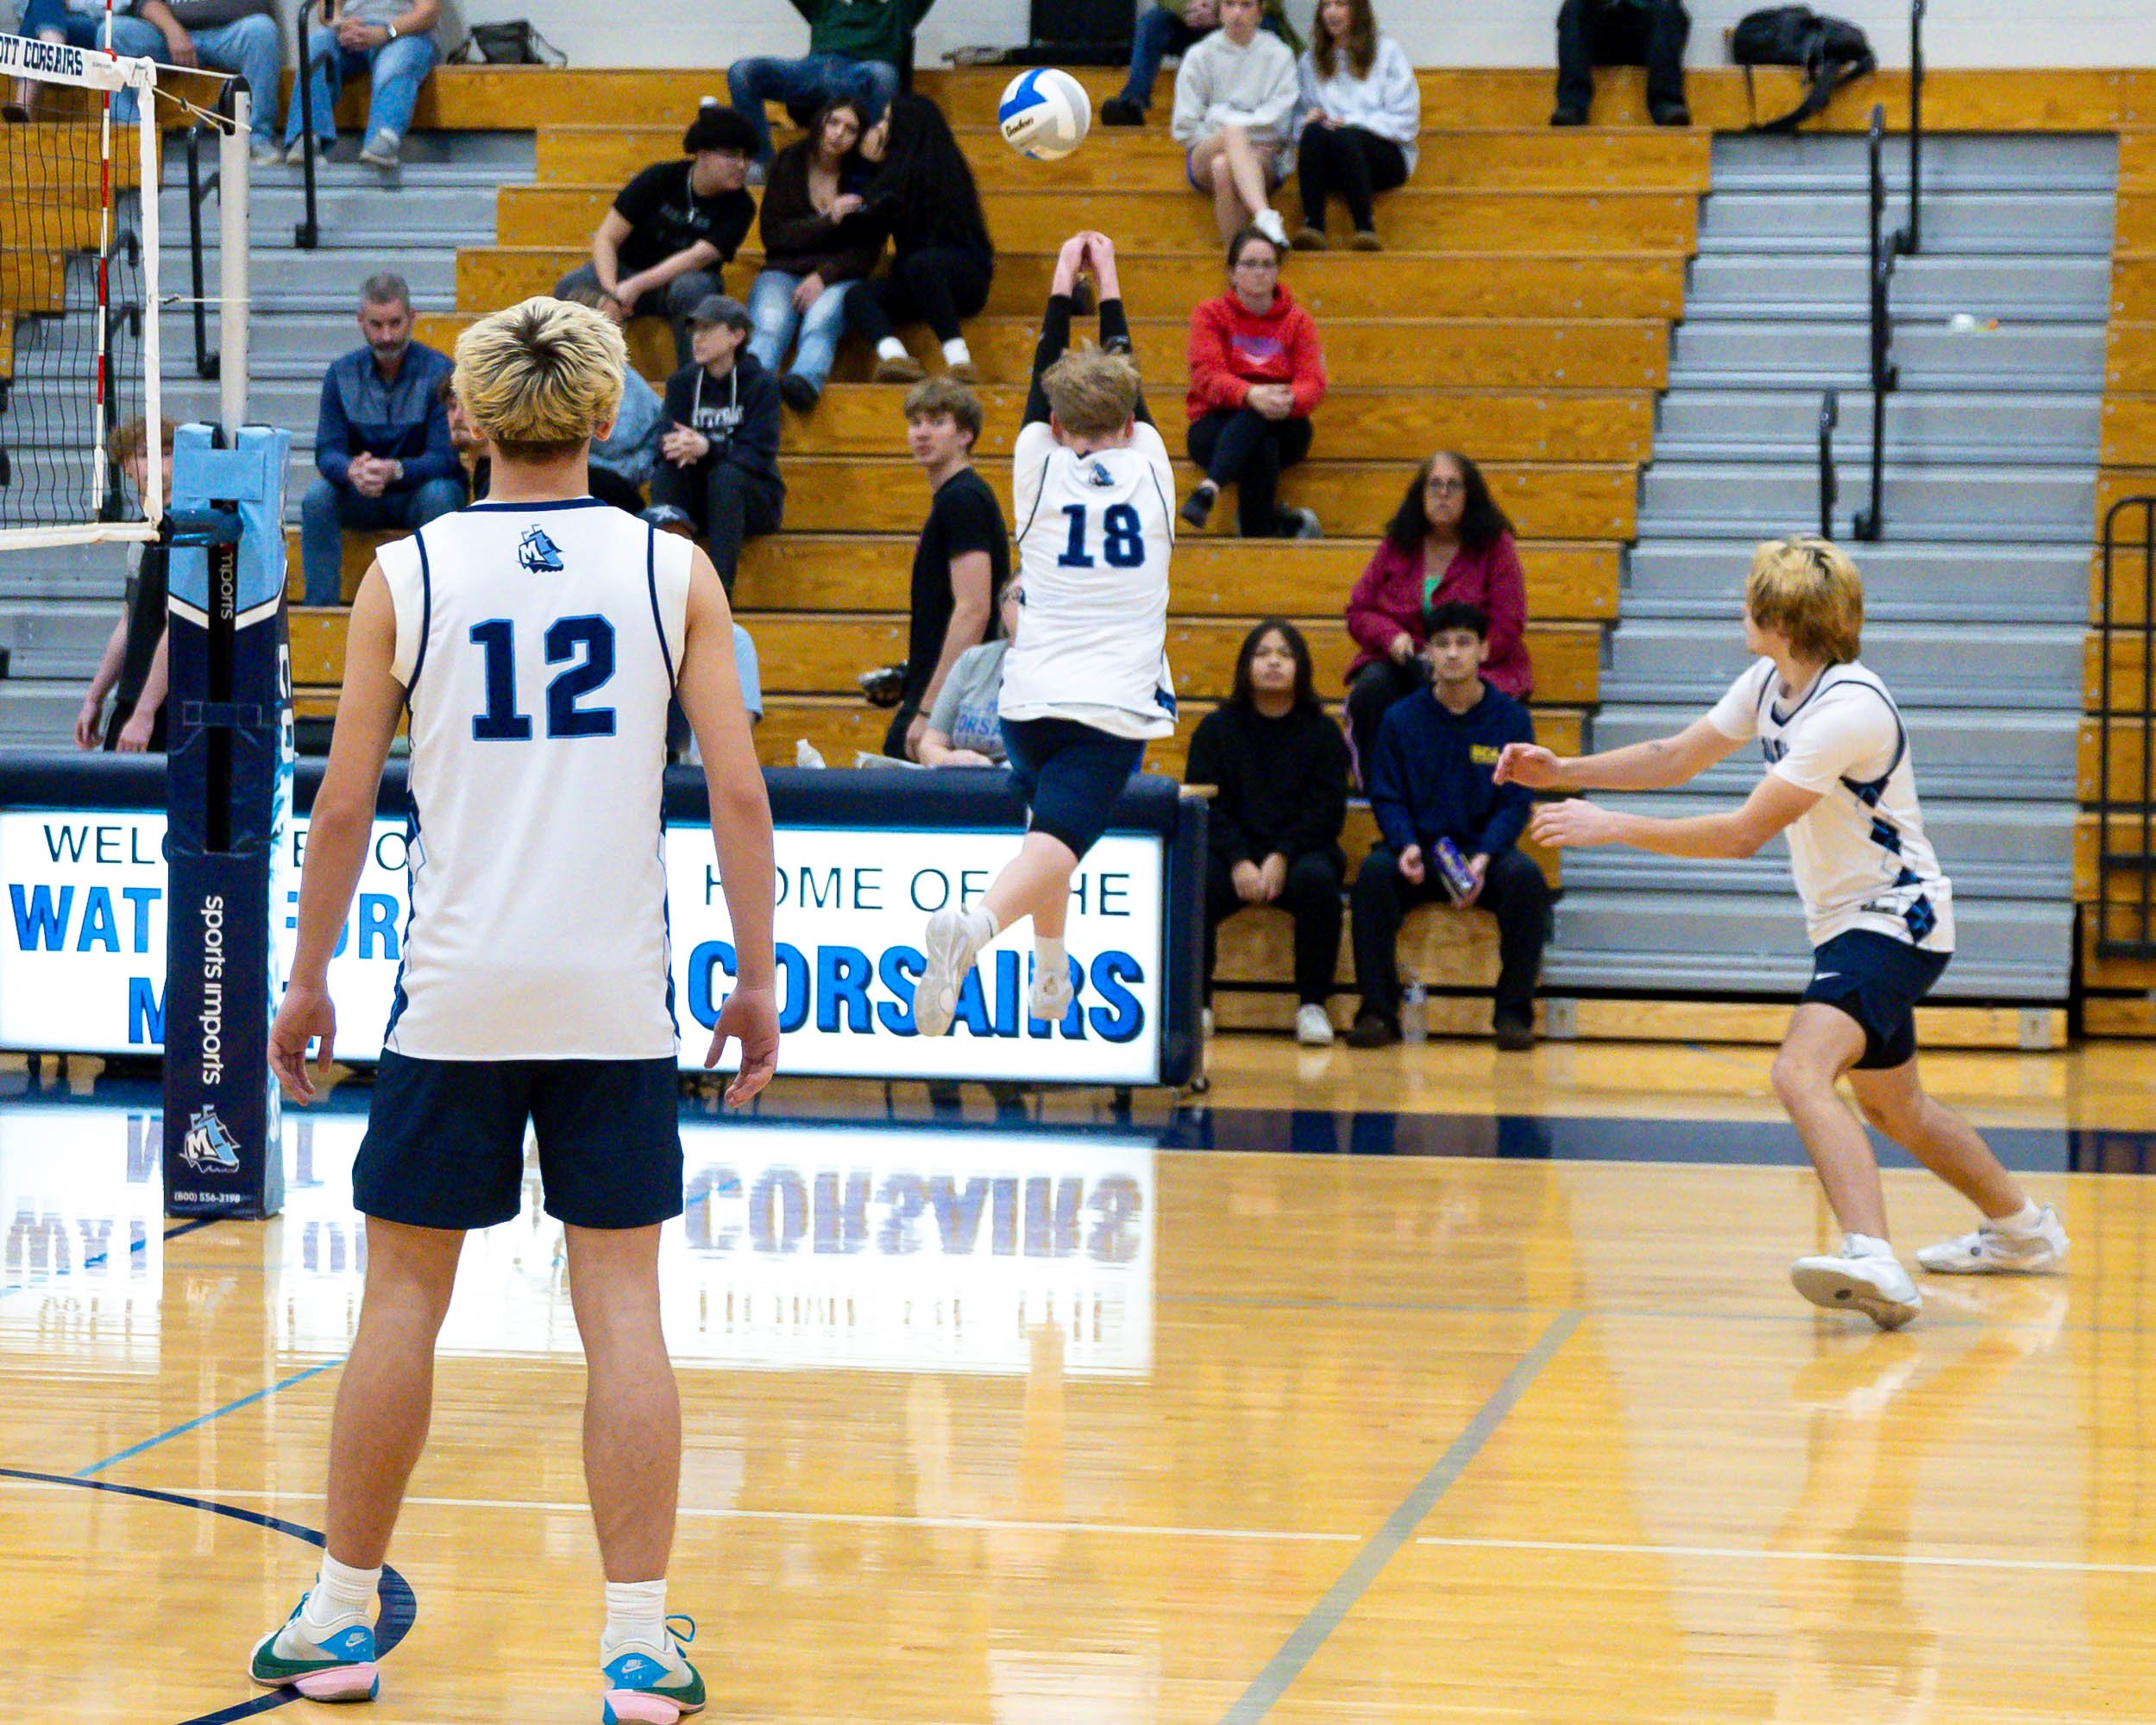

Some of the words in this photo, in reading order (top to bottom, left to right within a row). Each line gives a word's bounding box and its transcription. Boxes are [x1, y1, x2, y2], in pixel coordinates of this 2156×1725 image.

[23, 41, 83, 76] CORSAIRS
[1057, 503, 1145, 568] 18
[469, 614, 617, 741] 12
[910, 868, 989, 913] OF
[201, 895, 225, 979] sports
